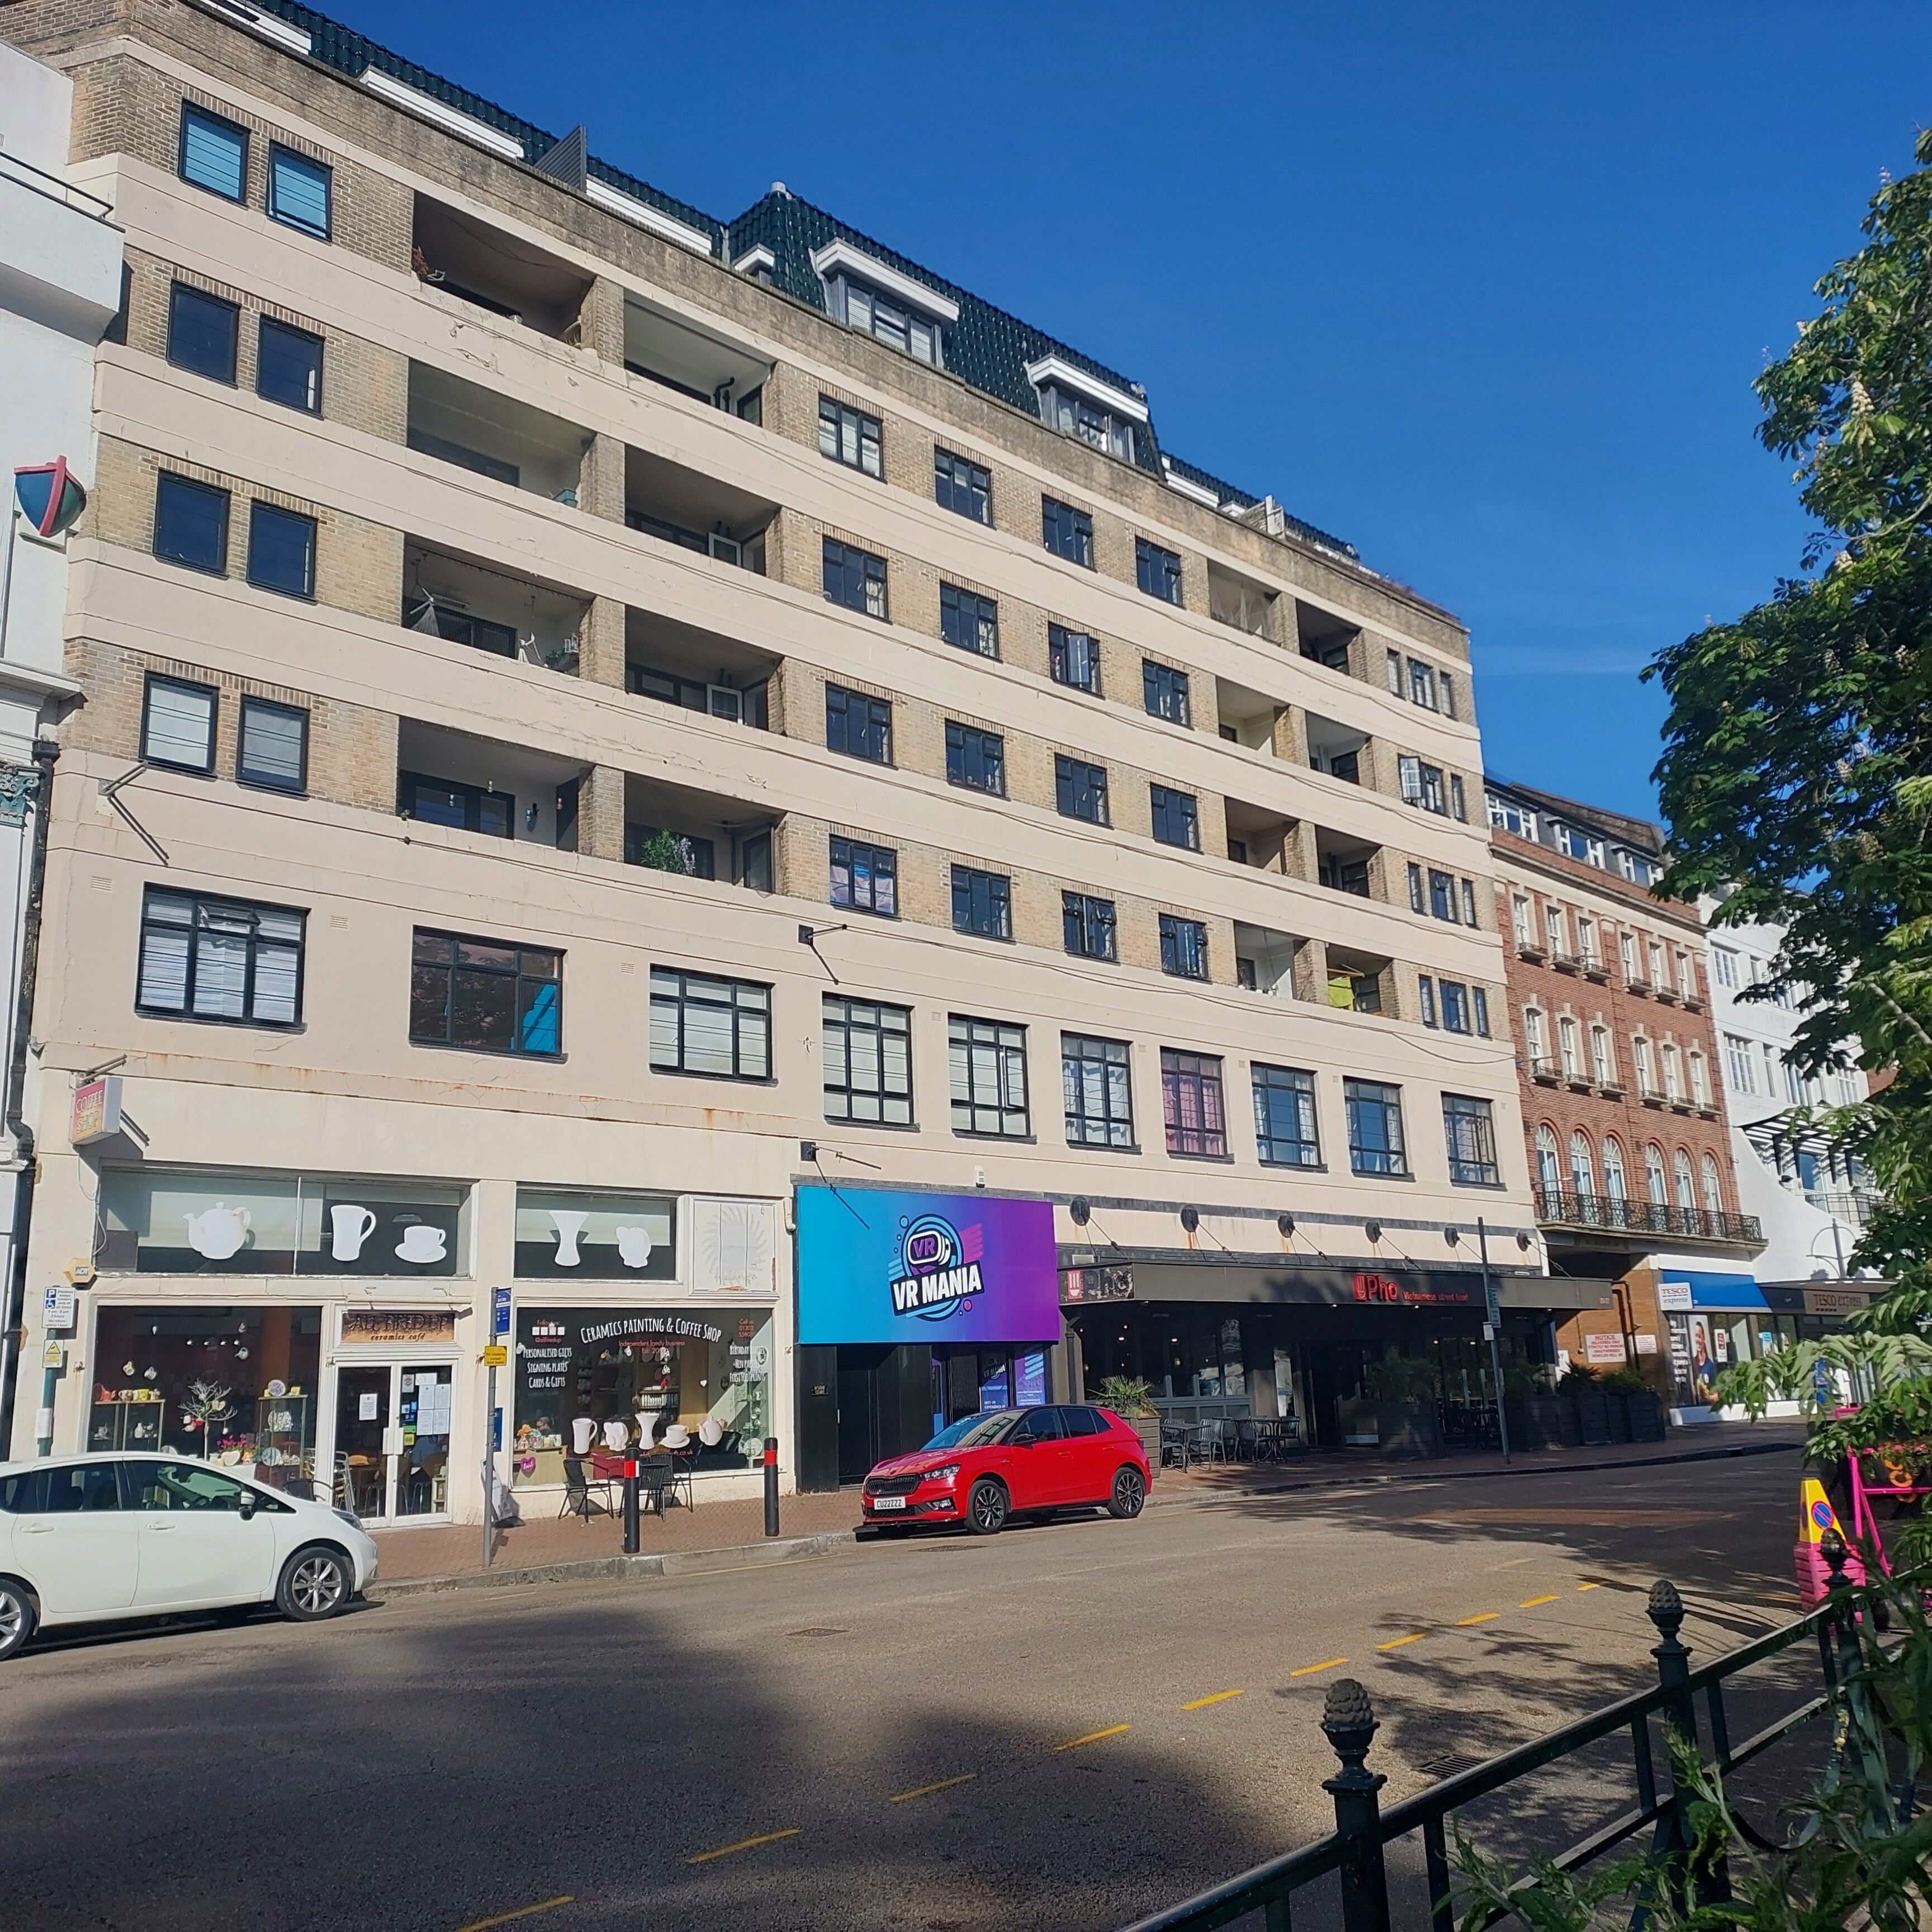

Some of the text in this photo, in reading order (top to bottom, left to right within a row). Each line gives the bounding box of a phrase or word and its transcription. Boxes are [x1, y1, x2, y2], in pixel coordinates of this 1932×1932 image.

[75, 1090, 103, 1114] COFFEE
[76, 1111, 99, 1134] SHOP
[913, 1238, 935, 1258] VR
[893, 1265, 982, 1310] VR MANIA
[1366, 1275, 1398, 1301] Pho
[1403, 1290, 1437, 1301] Vietnamese
[1813, 1294, 1836, 1306] TESCO
[427, 1315, 448, 1332] UP
[580, 1317, 722, 1343] CERAMICS PAINTING & COFFEE SHOP
[409, 1332, 425, 1342] café
[527, 1361, 568, 1374] SIGNING PLATES
[529, 1376, 566, 1389] CARDS & GIFTS
[877, 1499, 902, 1508] CU22ZZZ
